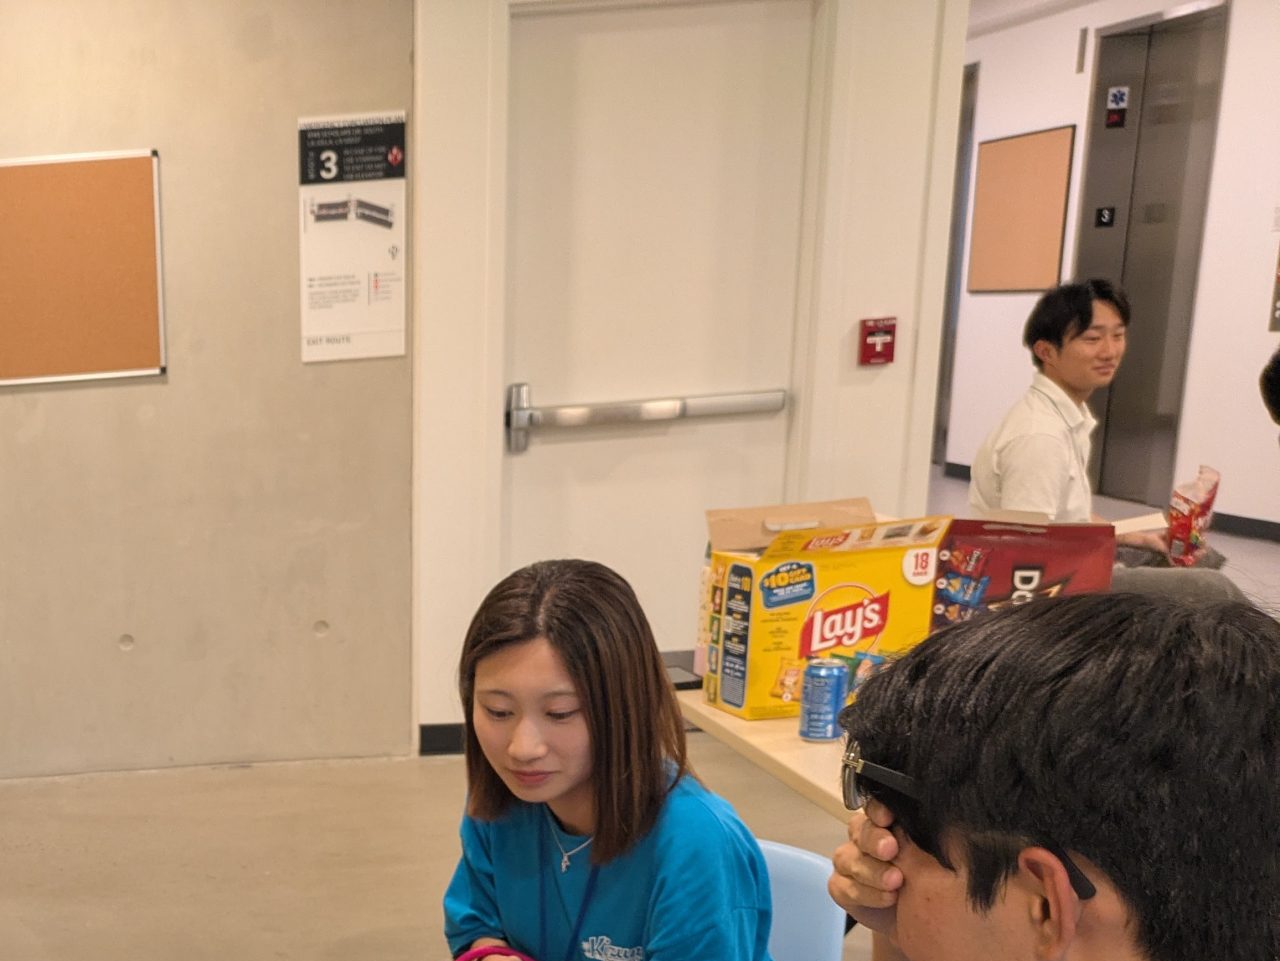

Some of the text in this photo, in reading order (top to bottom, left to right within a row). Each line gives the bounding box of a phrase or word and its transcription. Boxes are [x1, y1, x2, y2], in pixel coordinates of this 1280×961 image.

[320, 150, 338, 179] 3
[913, 552, 929, 570] 18
[810, 598, 881, 652] Lay's
